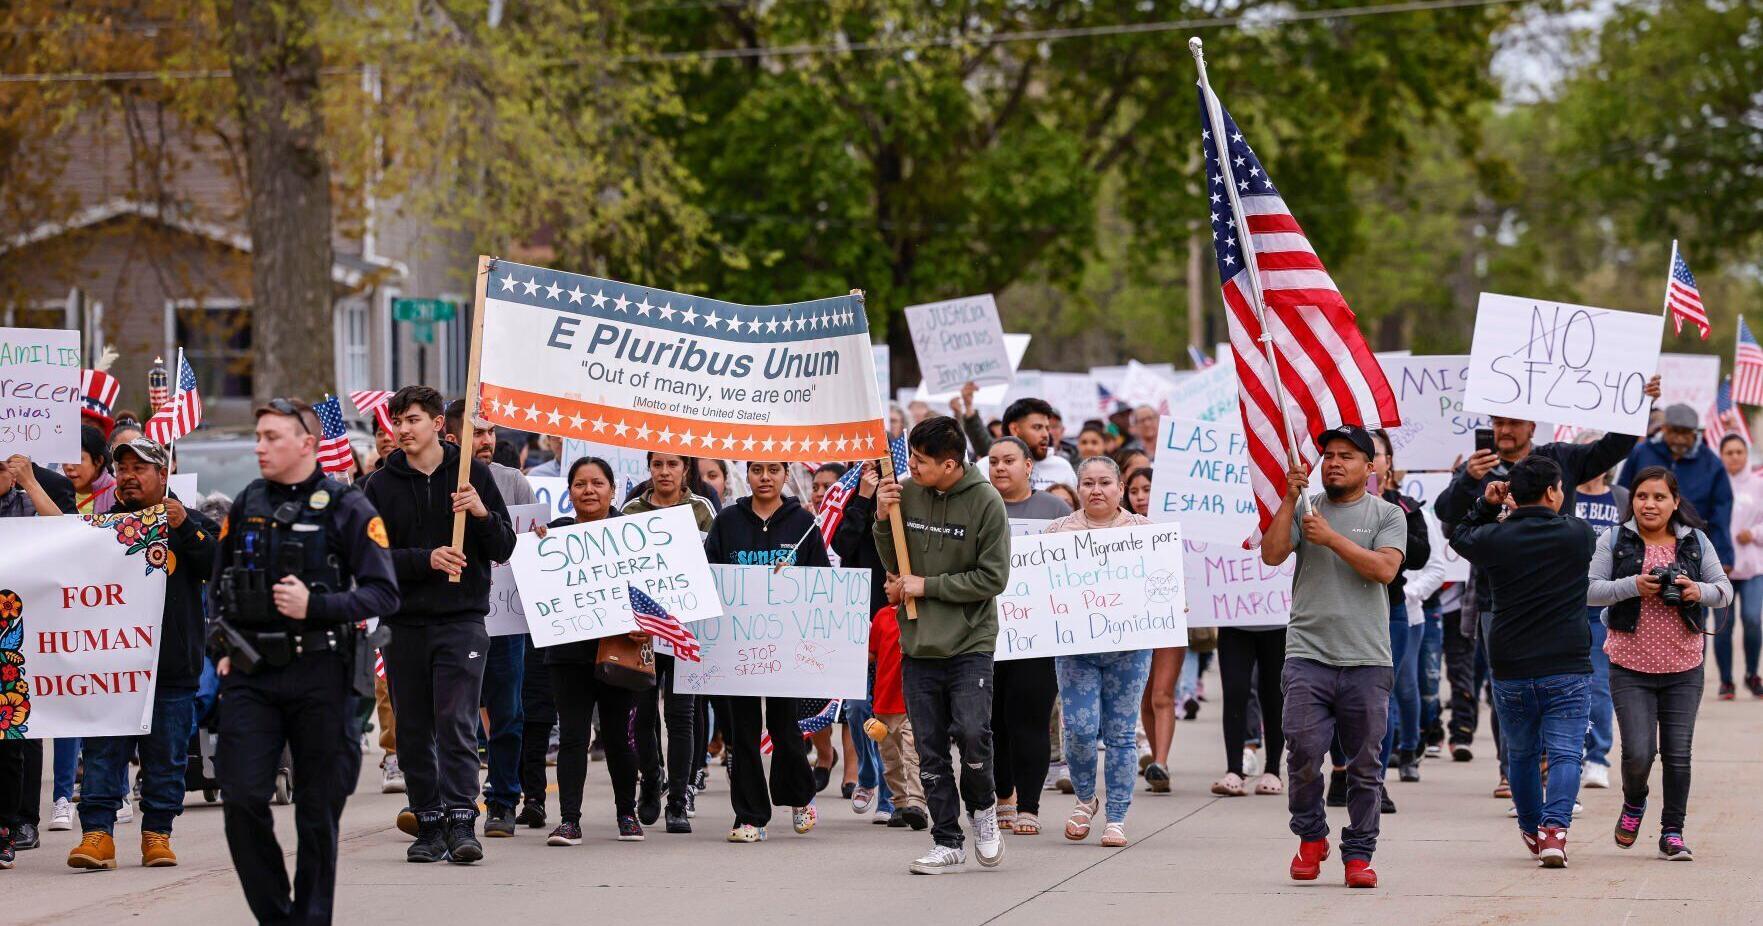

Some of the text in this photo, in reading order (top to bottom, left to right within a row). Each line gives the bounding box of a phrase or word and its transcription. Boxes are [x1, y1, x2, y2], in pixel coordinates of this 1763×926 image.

[547, 316, 839, 379] E Pluribus Unum
[1528, 305, 1595, 369] NO
[629, 371, 650, 388] of
[654, 377, 712, 402] many,
[720, 386, 746, 402] we
[751, 391, 779, 403] are
[1481, 355, 1646, 415] SF2340
[0, 405, 50, 420] nidas
[633, 395, 771, 423] [Motto of the United States]
[1167, 422, 1218, 452] LAS
[1189, 459, 1248, 484] MERE
[906, 521, 925, 530] UNDER
[1589, 503, 1620, 524] BLUE
[537, 516, 673, 572] SOMOS
[1010, 541, 1066, 569] archa
[1074, 531, 1143, 567] Migrante
[1152, 530, 1178, 551] por:
[566, 553, 668, 587] LA FUERZA
[1047, 555, 1147, 591] libertad
[61, 583, 126, 609] FOR
[536, 573, 690, 617] DE ESTE PAIS
[767, 566, 871, 608] ESTAMOS
[551, 607, 608, 636] STOP
[1001, 589, 1124, 623] Por la Paz
[37, 625, 154, 654] HUMAN
[732, 613, 784, 641] NOS
[791, 607, 869, 642] VAMOS
[1003, 606, 1176, 653] Por la Dignidad
[734, 659, 782, 676] SF2340
[738, 644, 778, 662] STOP
